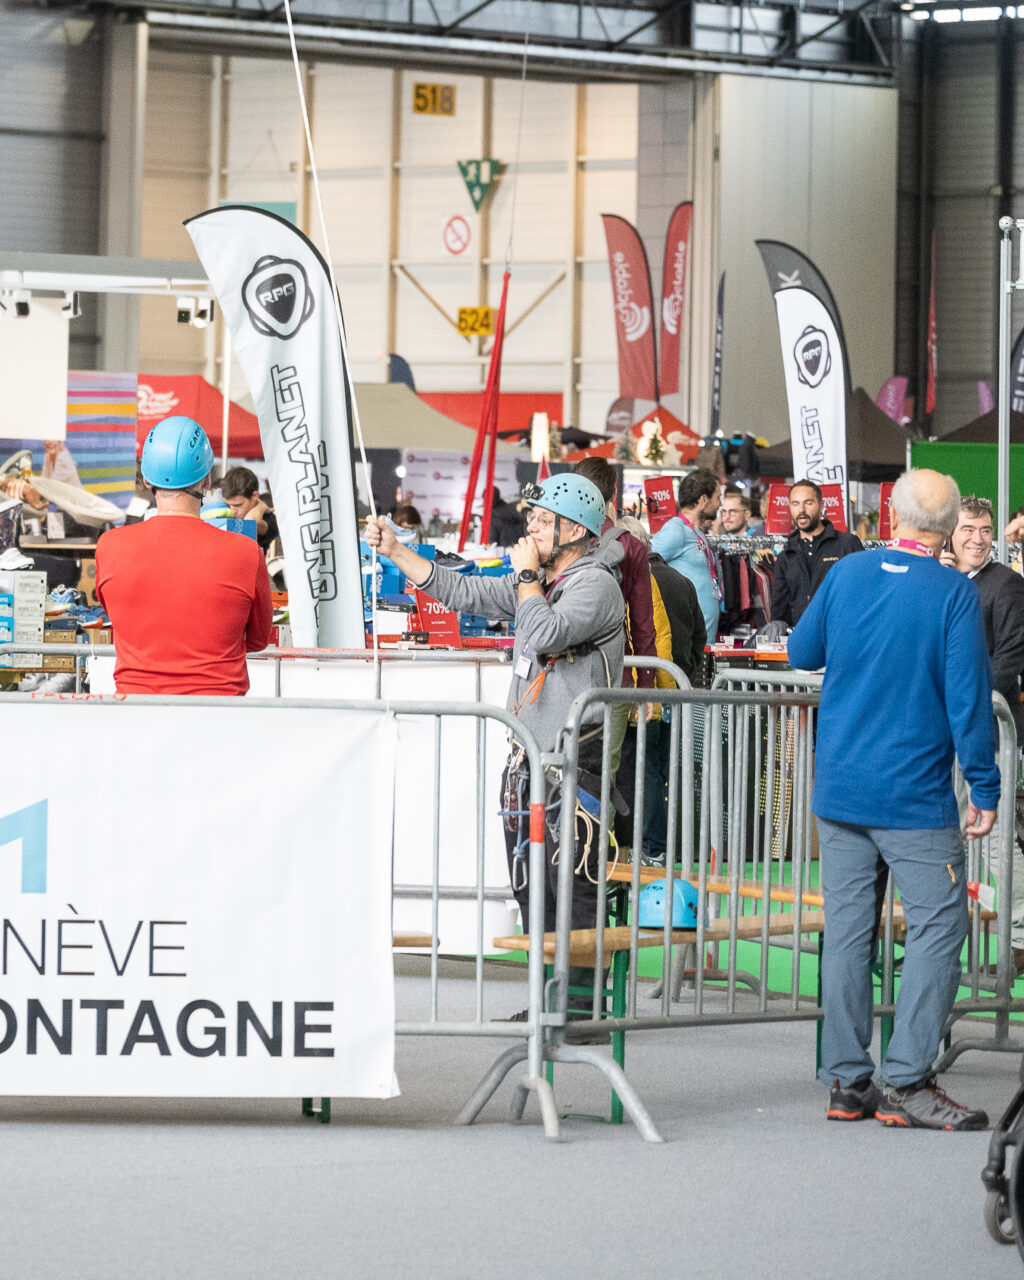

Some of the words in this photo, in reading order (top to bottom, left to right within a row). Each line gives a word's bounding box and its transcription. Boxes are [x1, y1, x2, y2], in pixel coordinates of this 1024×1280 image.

[415, 84, 453, 113] 518
[258, 282, 295, 307] RPG
[271, 364, 321, 516] PLANET
[800, 405, 825, 485] ANET
[651, 490, 670, 501] 70%
[423, 603, 449, 614] -70%
